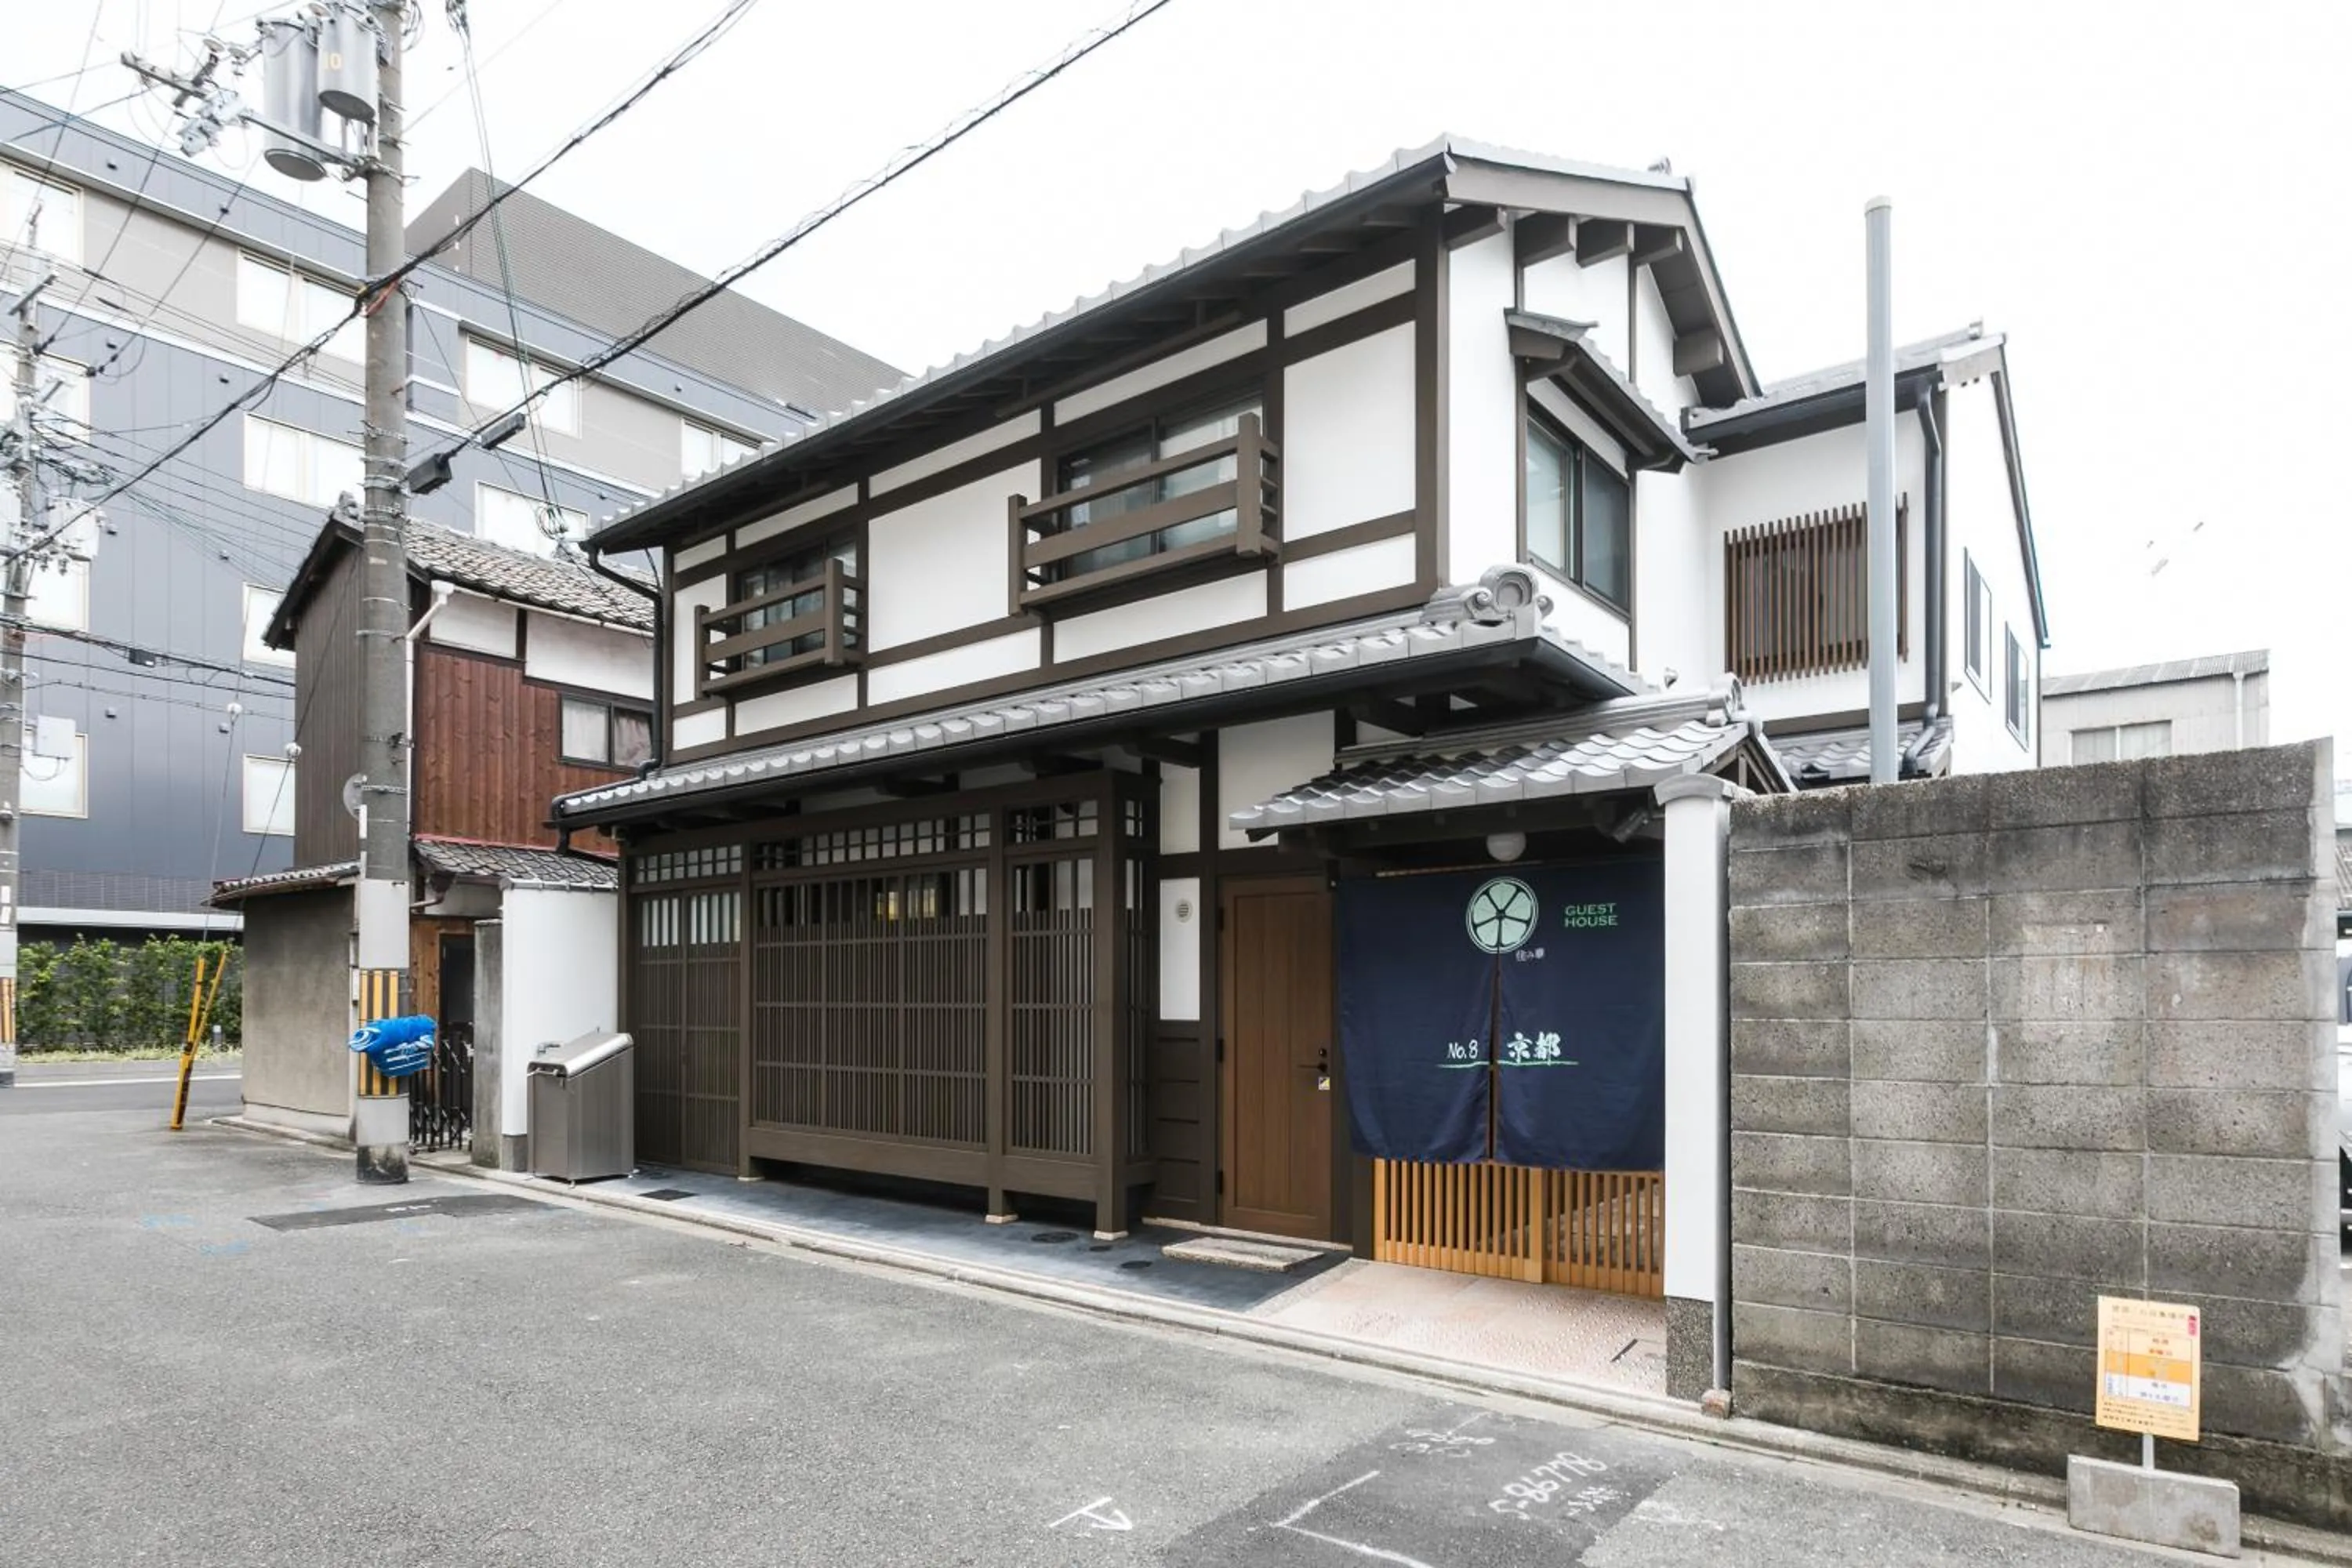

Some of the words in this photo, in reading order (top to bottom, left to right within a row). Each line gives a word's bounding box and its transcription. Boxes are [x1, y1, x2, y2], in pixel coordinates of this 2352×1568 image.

[322, 52, 342, 70] 10
[1565, 902, 1617, 916] GUEST
[1565, 916, 1618, 927] HOUSE
[1446, 1040, 1478, 1058] No.8
[1507, 1031, 1560, 1065] 京都
